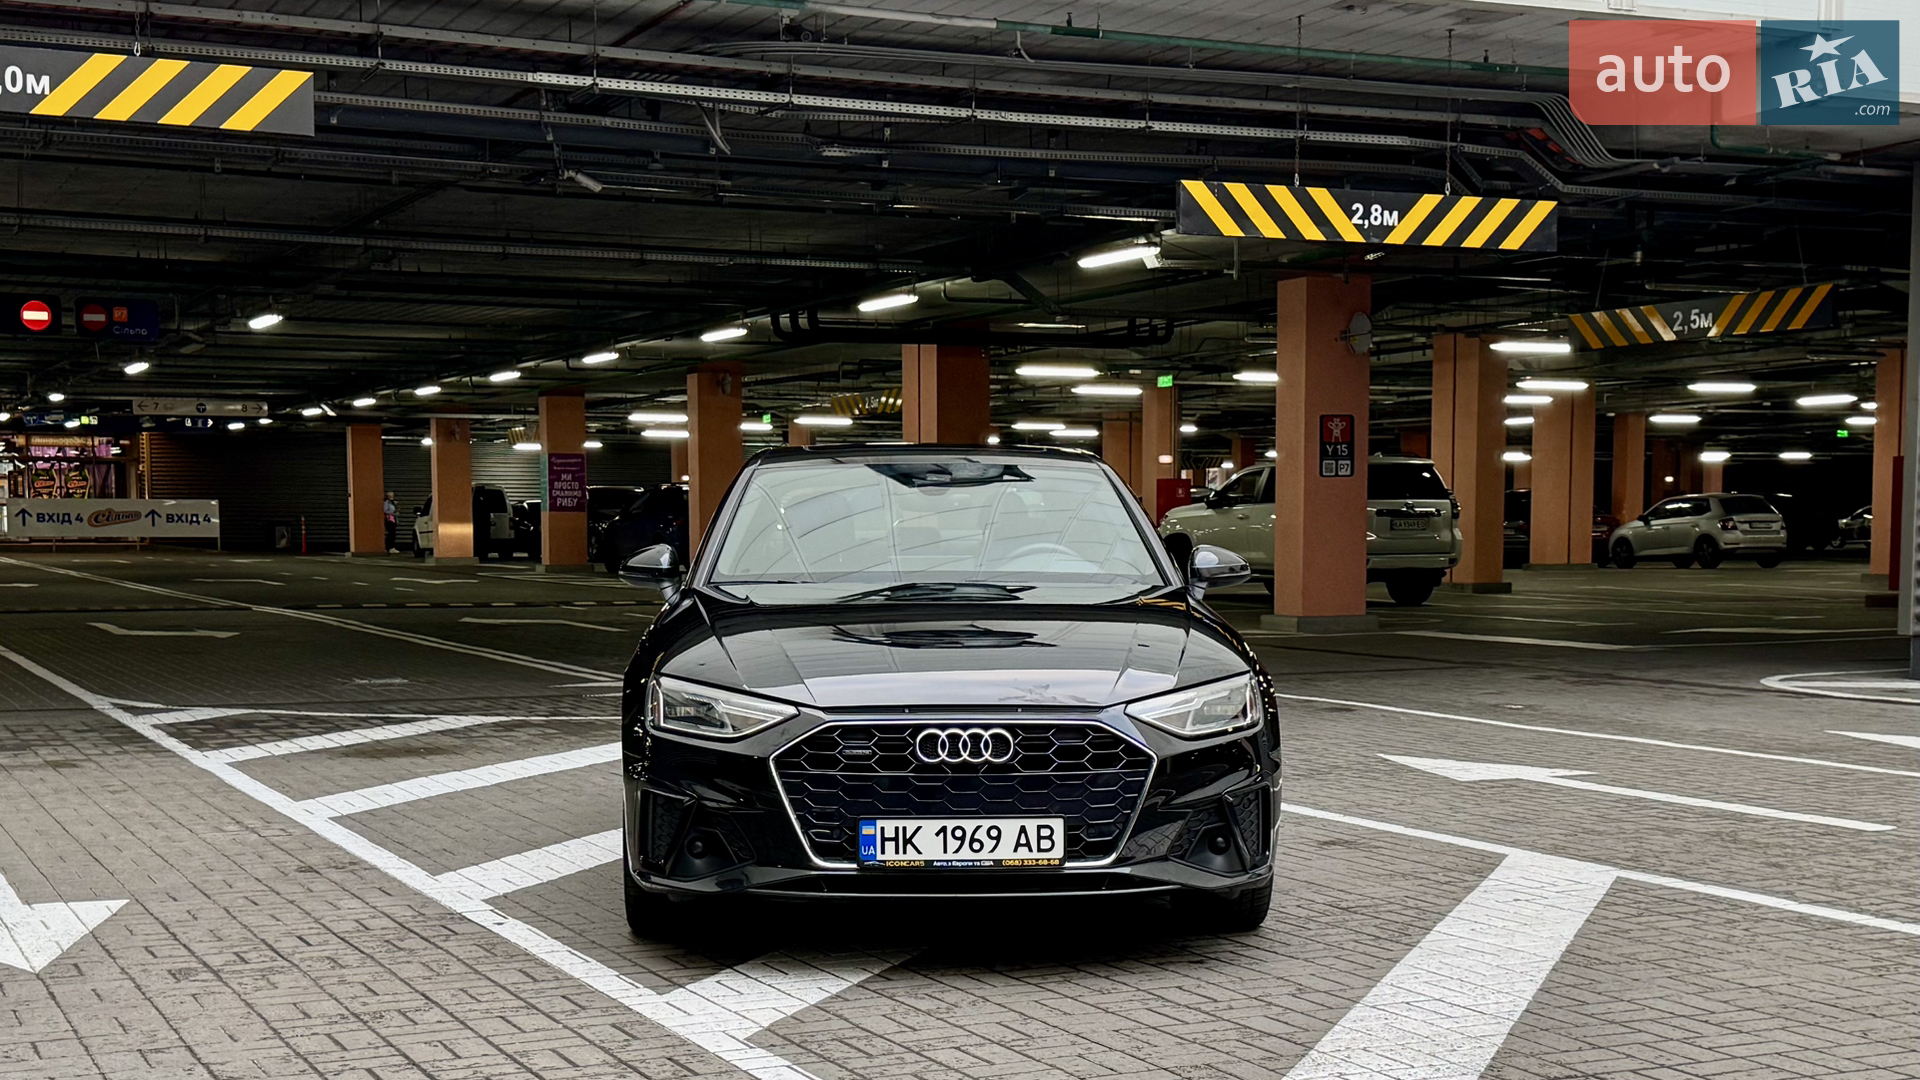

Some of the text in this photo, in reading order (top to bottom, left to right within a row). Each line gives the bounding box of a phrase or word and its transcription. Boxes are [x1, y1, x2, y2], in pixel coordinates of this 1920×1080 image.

[0, 65, 50, 95] 0м
[113, 325, 148, 335] Сільпо
[153, 402, 159, 411] 7
[241, 404, 248, 413] 8
[1326, 444, 1348, 455] Y 15
[1339, 463, 1350, 472] P7
[553, 481, 579, 490] ПРОСТО
[556, 497, 578, 507] РИБУ
[36, 513, 84, 525] ВХІД 4
[166, 513, 211, 525] ВХІД 4
[879, 825, 1056, 855] HK 1969 AB
[861, 846, 876, 855] UA
